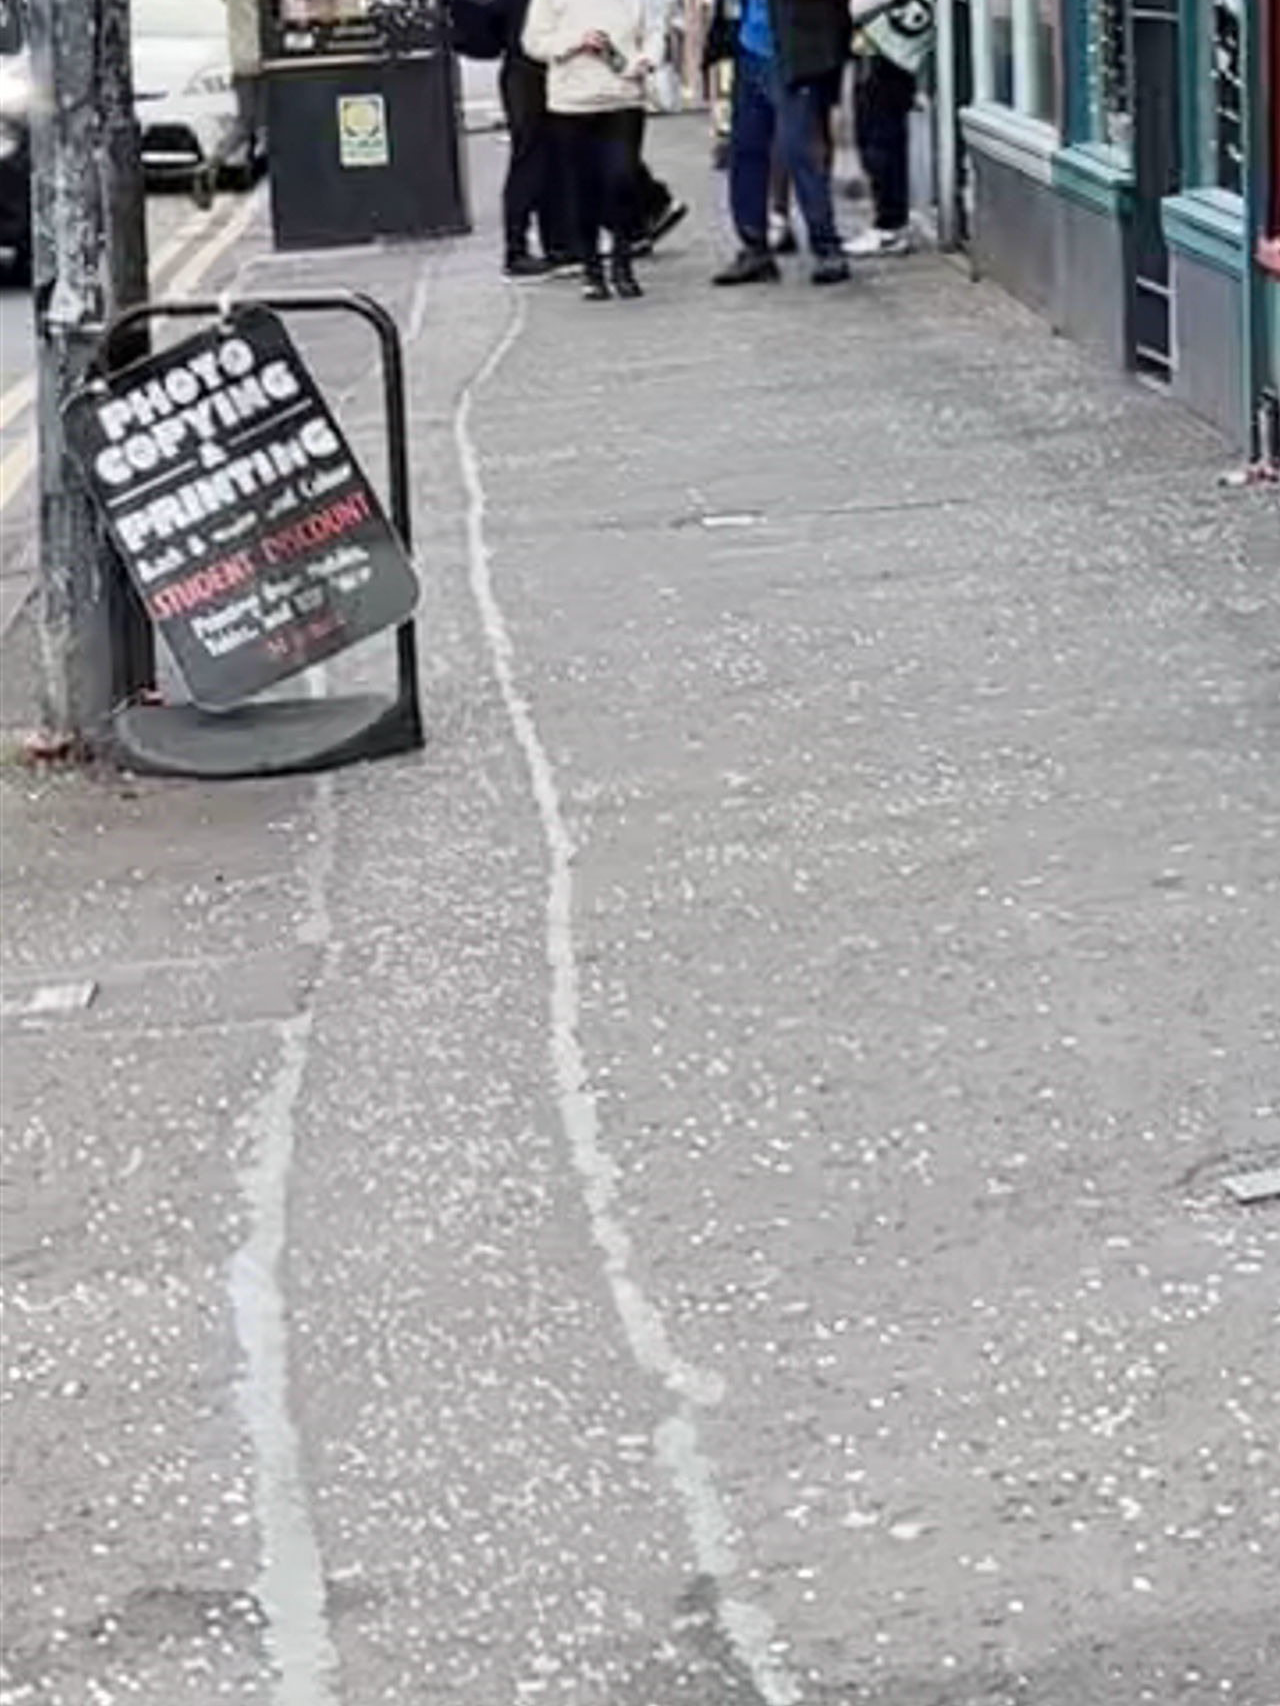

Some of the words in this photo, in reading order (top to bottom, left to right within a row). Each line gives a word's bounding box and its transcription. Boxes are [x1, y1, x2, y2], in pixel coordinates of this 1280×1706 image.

[96, 360, 300, 485] COPYING
[97, 338, 255, 441] PHOTO
[115, 417, 340, 554] PRINTING
[199, 440, 227, 469] &
[152, 550, 256, 619] STUDENT
[260, 491, 370, 565] DISCOUNT
